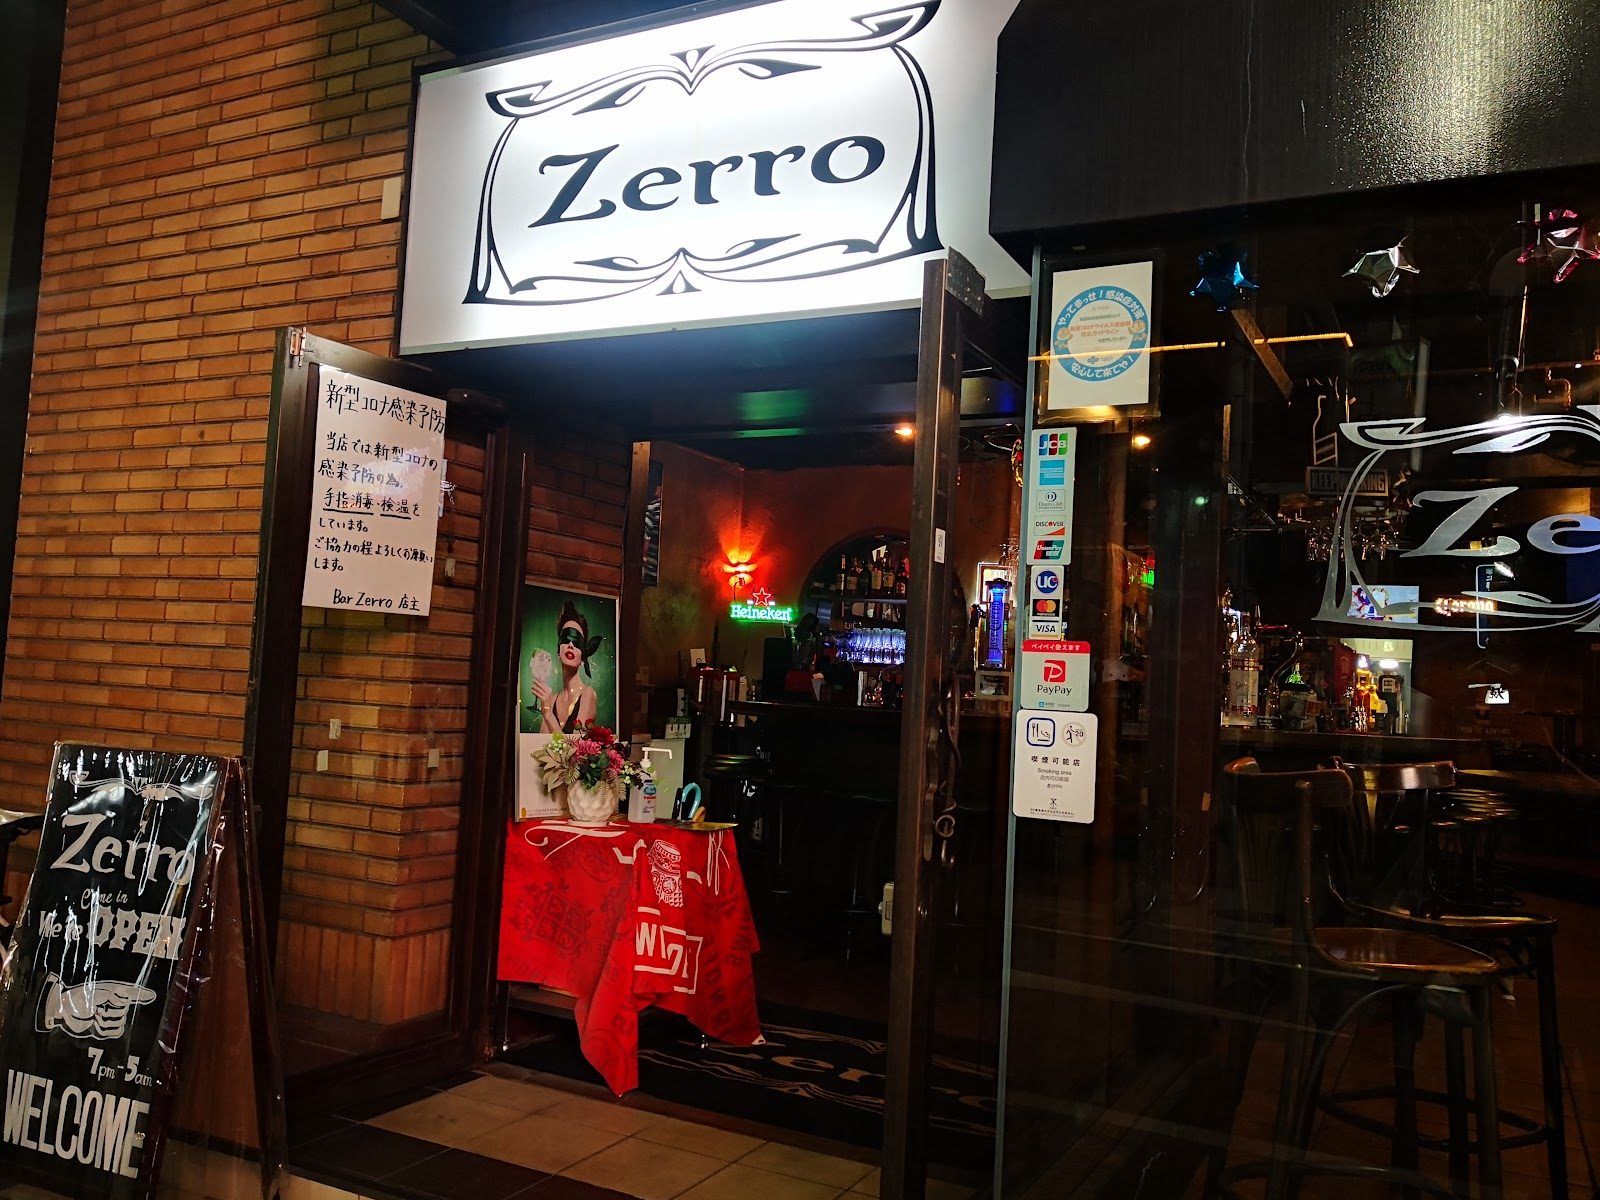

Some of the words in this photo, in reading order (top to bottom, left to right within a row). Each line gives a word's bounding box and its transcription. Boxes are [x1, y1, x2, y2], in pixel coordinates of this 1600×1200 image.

[527, 135, 886, 228] Zerro
[326, 379, 445, 434] 新型コロナ感染予防
[326, 431, 438, 471] 当店では新型コロナの
[319, 517, 368, 532] しています。
[314, 537, 433, 563] ご協力の程よろしくお願い
[314, 557, 344, 571] します。
[1037, 576, 1058, 588] UC
[333, 588, 354, 605] Bar
[355, 592, 393, 608] Zerro
[398, 594, 420, 612] 店主
[730, 604, 792, 621] Heineken
[1035, 625, 1056, 633] VISA
[1036, 685, 1072, 696] PayPay
[1031, 755, 1081, 767] 喫煙可能店
[50, 813, 196, 886] Zerro
[80, 888, 113, 910] Cme
[86, 905, 187, 961] OPEN
[3, 1069, 150, 1179] WELCOME
